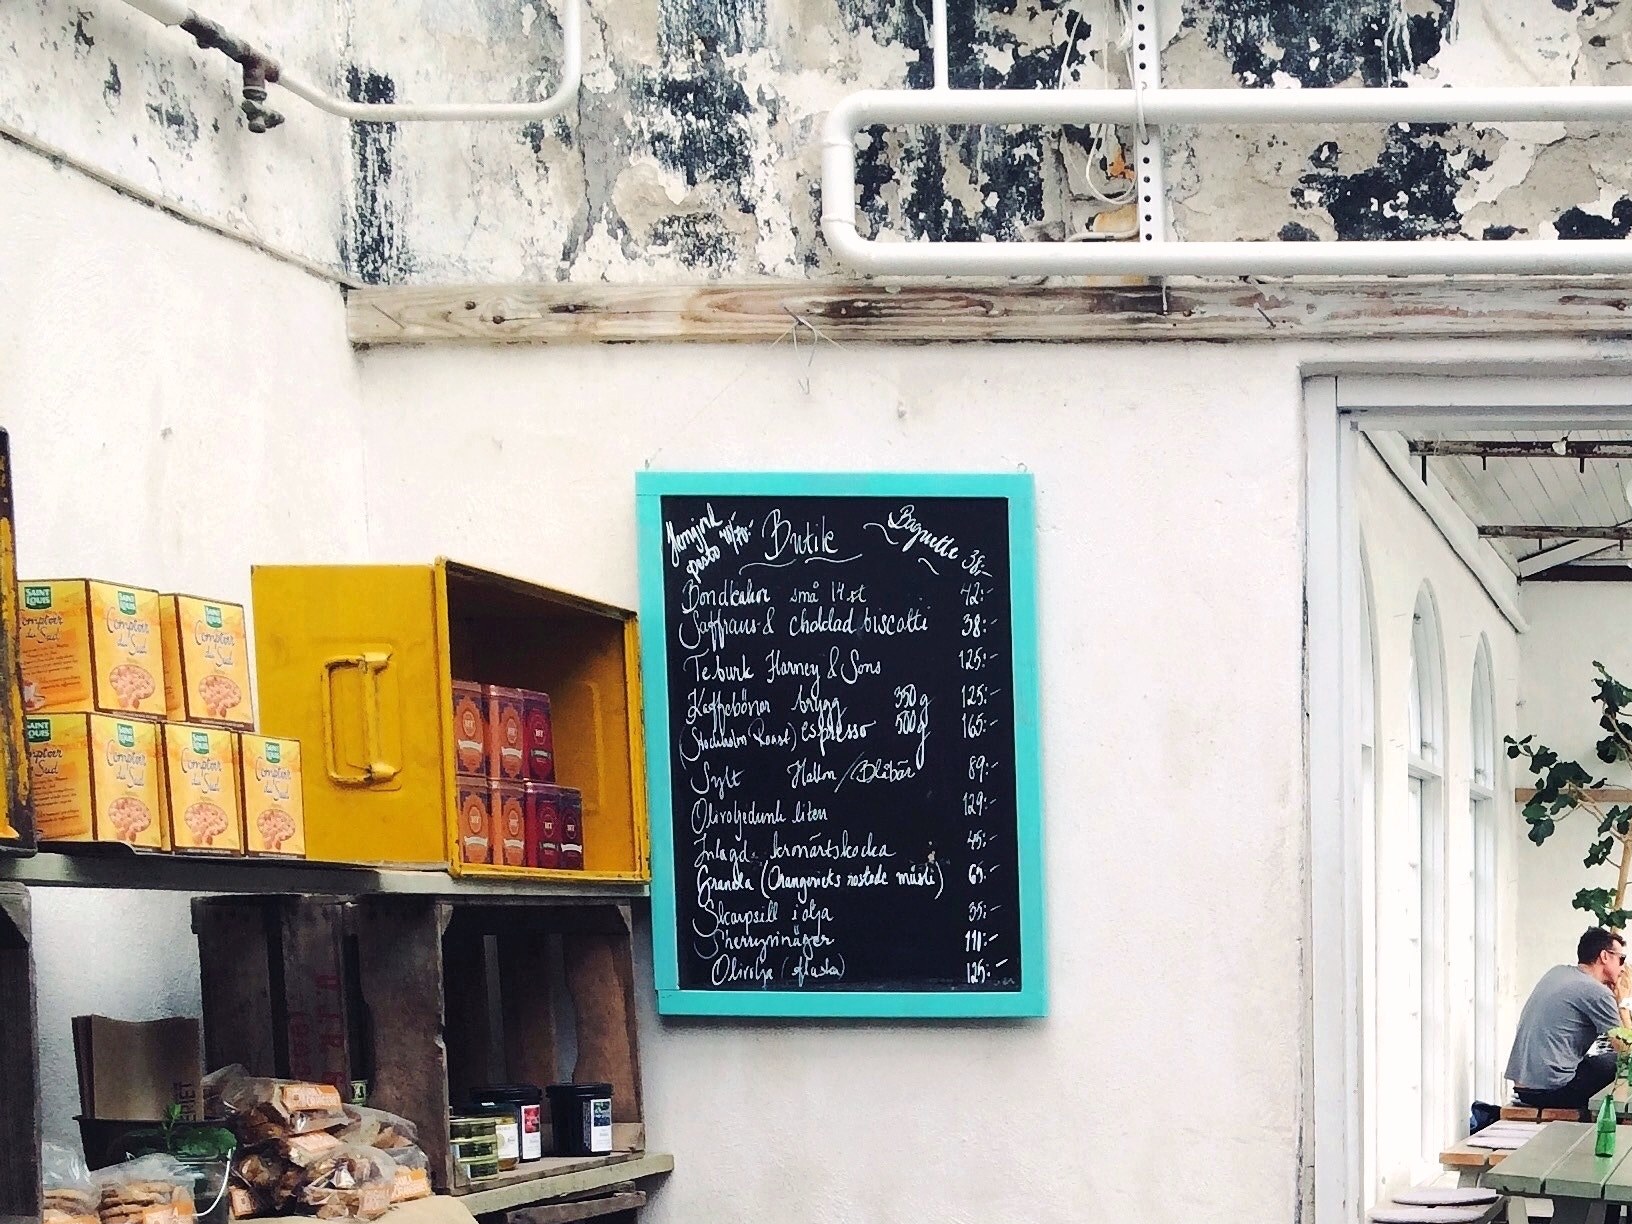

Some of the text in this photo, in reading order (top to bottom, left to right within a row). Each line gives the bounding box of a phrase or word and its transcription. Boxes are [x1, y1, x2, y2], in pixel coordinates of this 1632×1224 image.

[762, 508, 838, 560] Butik
[789, 581, 820, 603] små
[841, 648, 881, 684] Sons
[800, 720, 877, 757] espresso
[690, 760, 745, 800] Sylt
